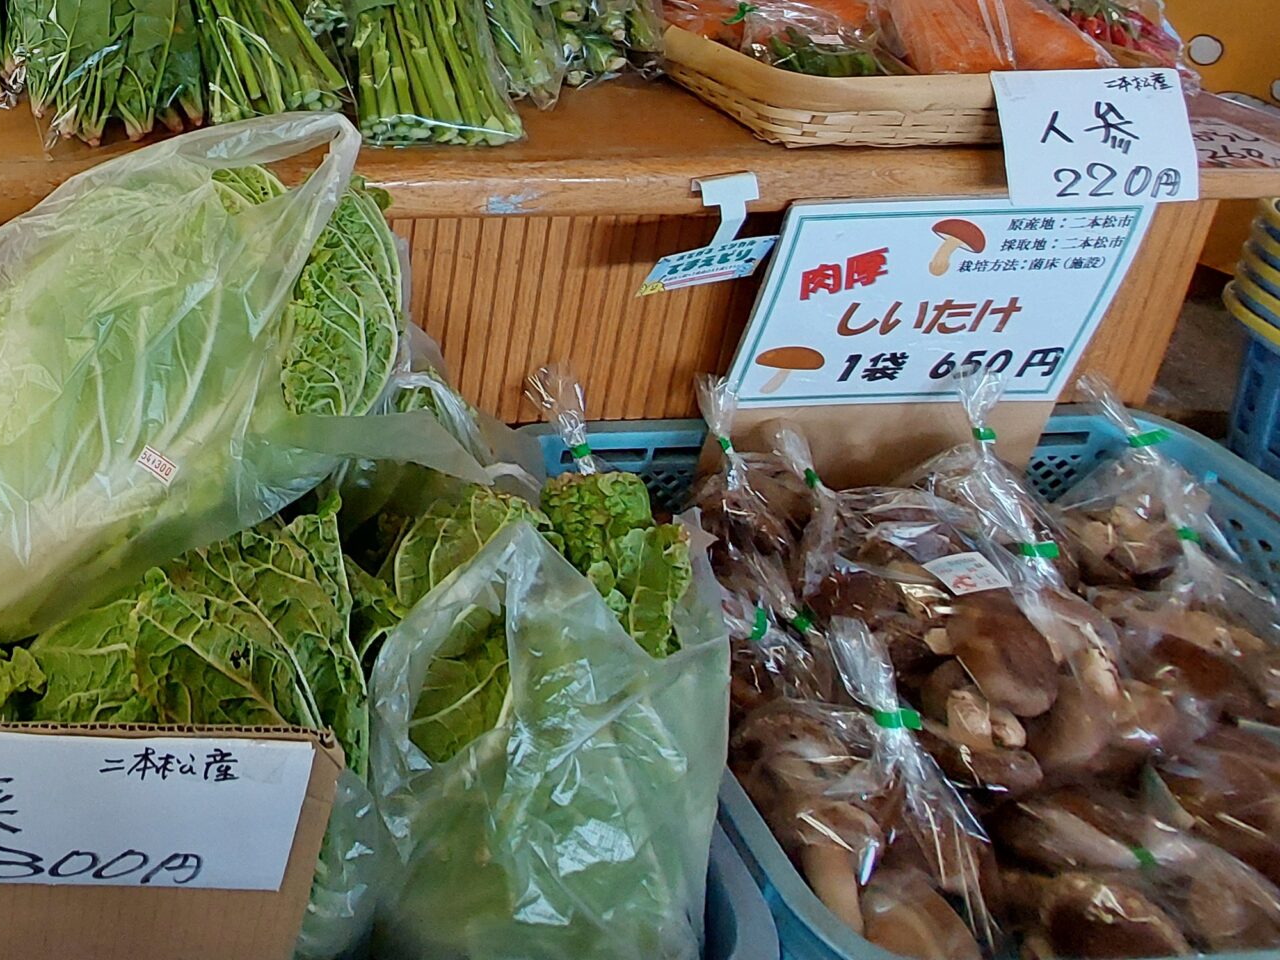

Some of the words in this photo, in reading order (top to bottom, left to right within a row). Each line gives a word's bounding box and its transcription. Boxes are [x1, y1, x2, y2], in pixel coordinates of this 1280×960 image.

[1053, 162, 1182, 199] 220円
[800, 247, 890, 301] 肉厚
[837, 296, 1023, 337] しいたけ
[836, 351, 910, 382] 1袋
[928, 347, 1065, 380] 650円
[99, 747, 241, 783] 二本松産
